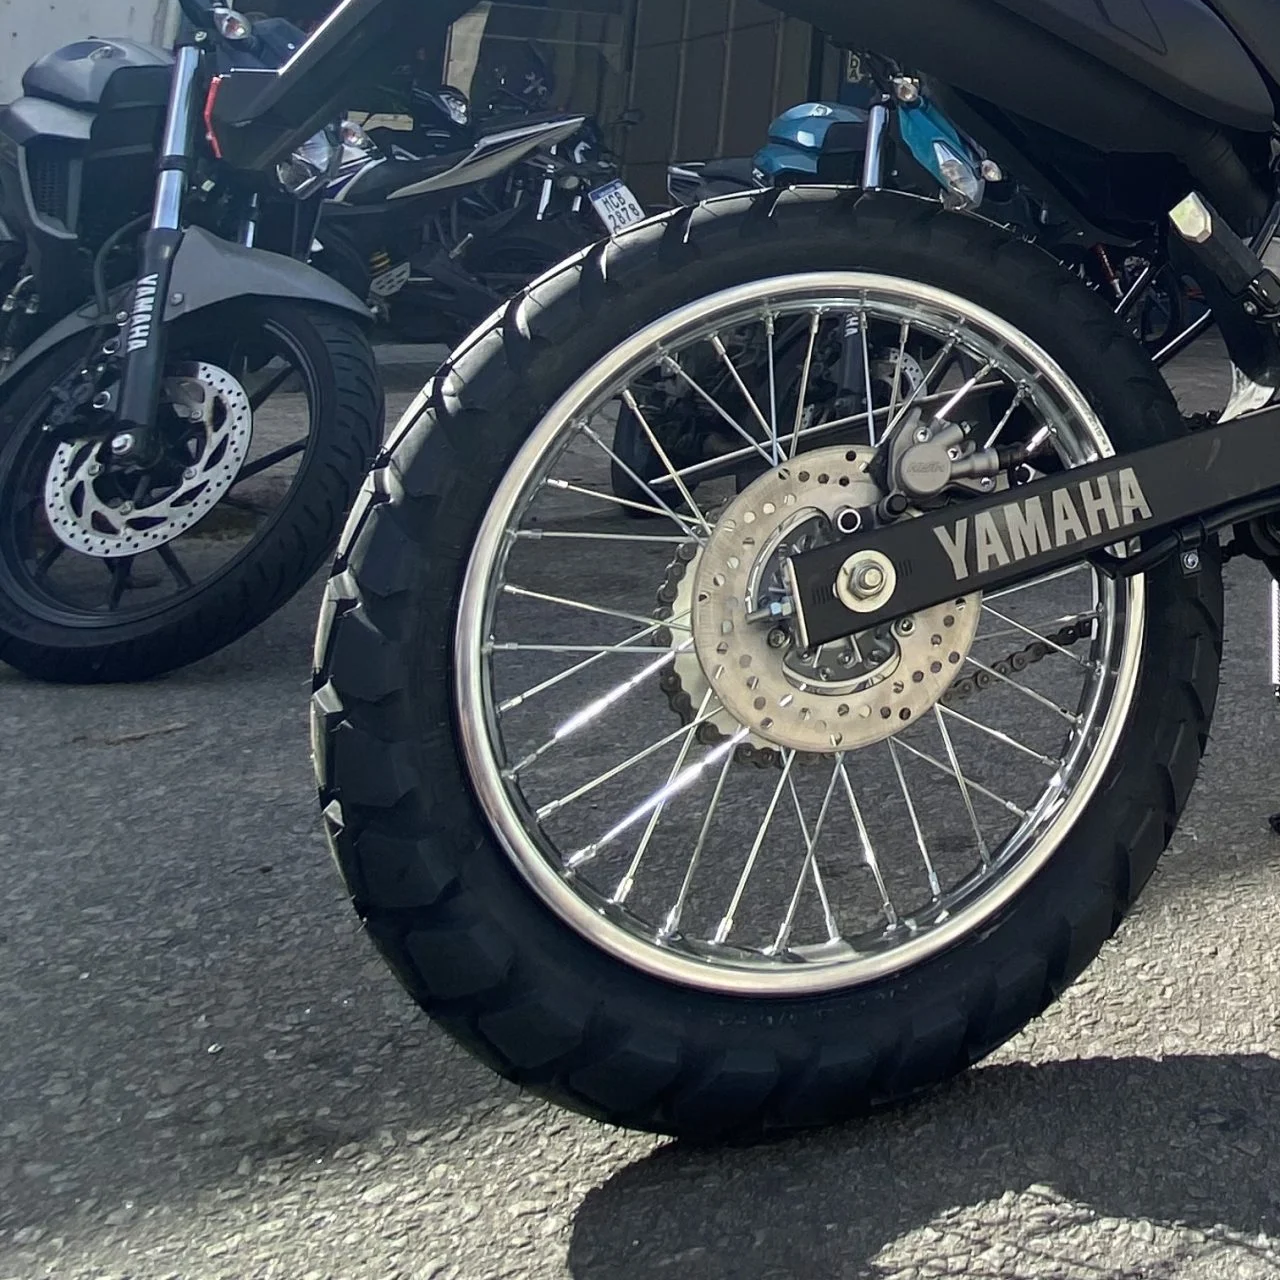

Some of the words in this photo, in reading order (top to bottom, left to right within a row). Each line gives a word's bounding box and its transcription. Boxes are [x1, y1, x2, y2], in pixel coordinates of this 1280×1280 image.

[601, 191, 626, 213] MCB
[607, 203, 640, 231] 2878
[127, 273, 159, 352] YAMAHA
[933, 466, 1154, 581] YAMAHA
